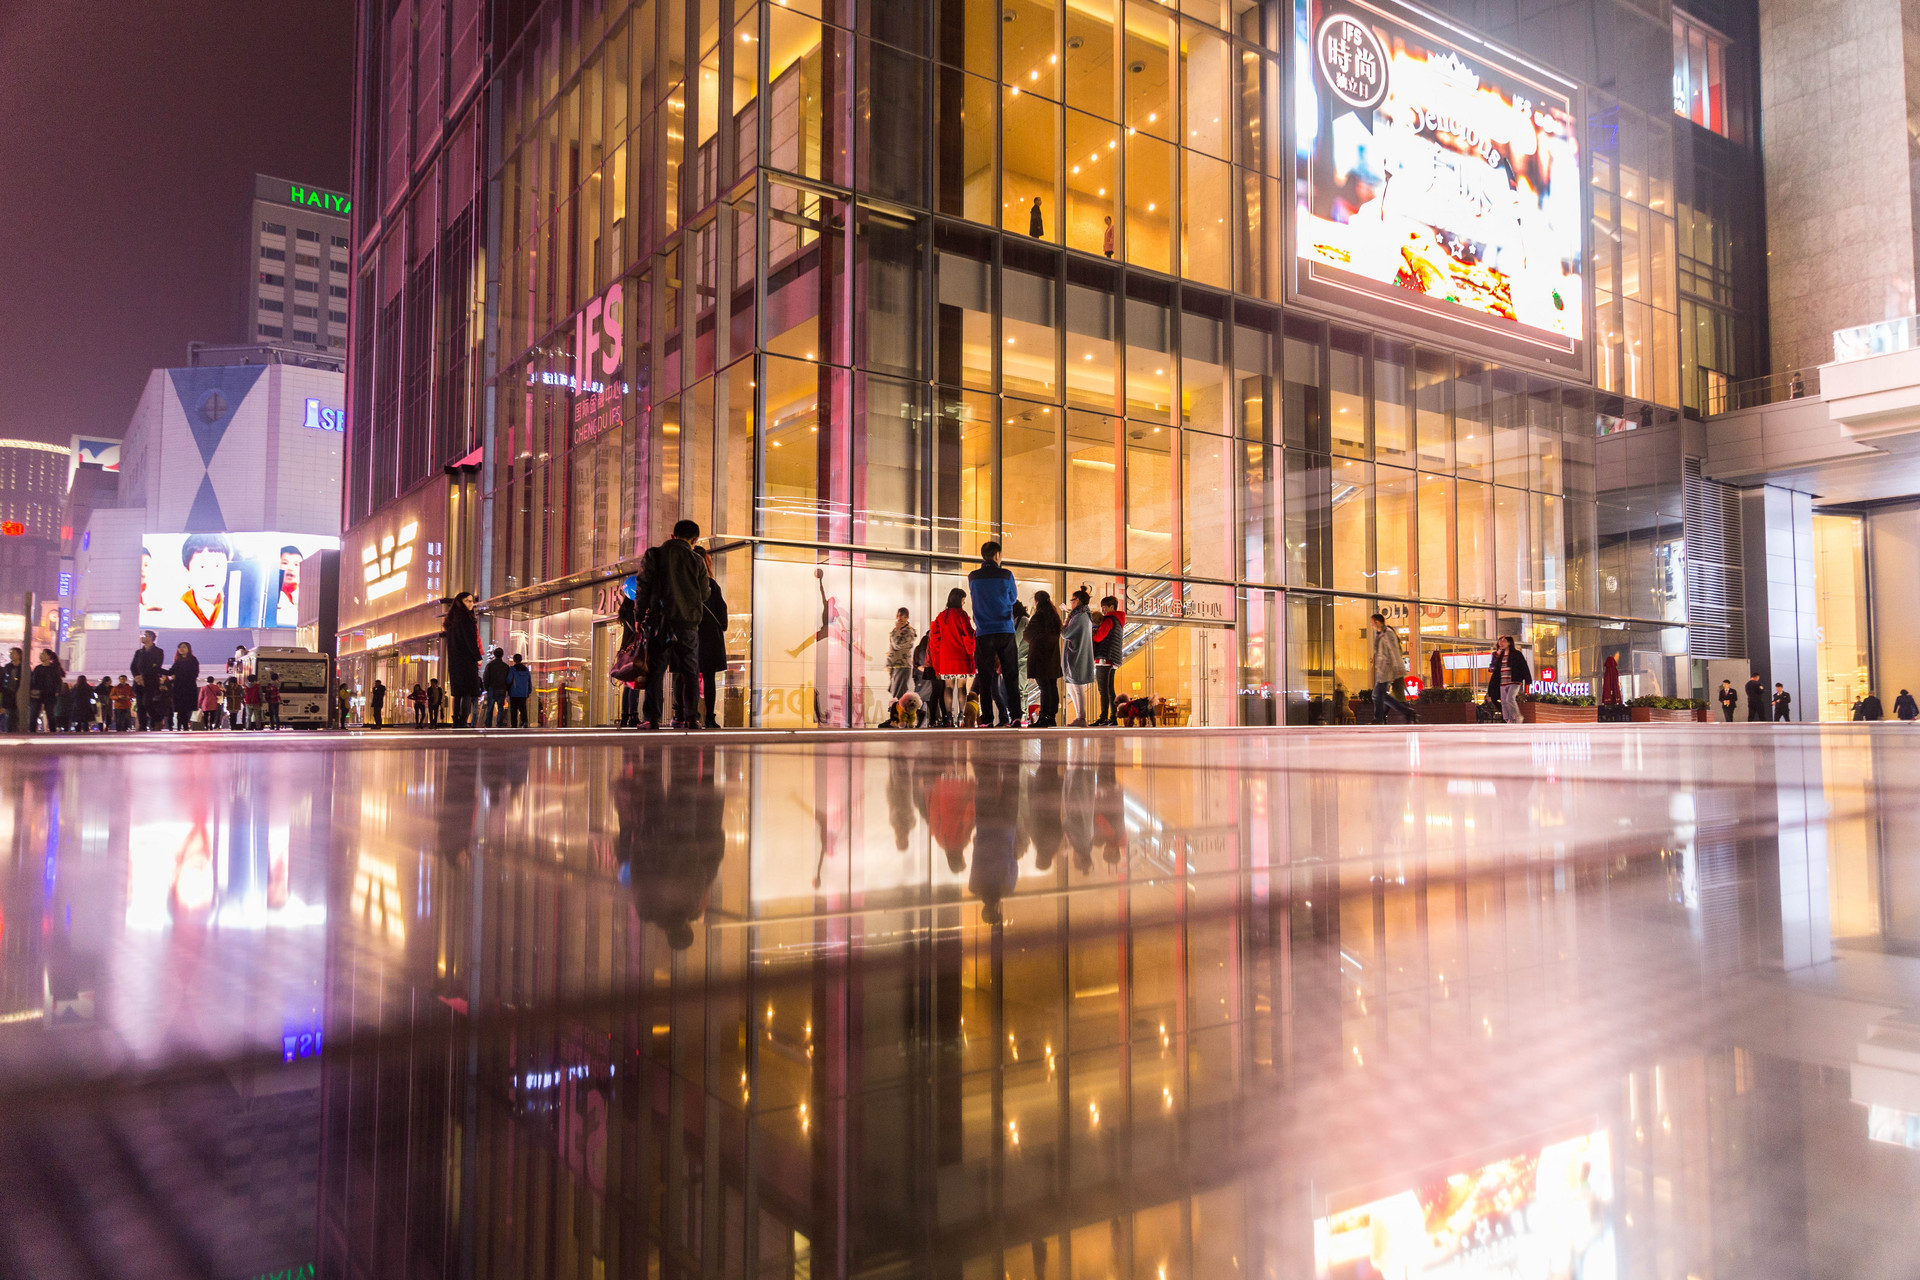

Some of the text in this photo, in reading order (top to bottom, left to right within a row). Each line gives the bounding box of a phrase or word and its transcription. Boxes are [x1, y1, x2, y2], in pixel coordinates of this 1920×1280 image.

[1342, 21, 1363, 46] IFS
[1327, 35, 1377, 85] 時尚
[575, 283, 622, 397] IFS
[575, 380, 621, 422] 国际金融中心
[574, 405, 621, 444] CHENGDU IFS
[597, 584, 624, 615] 2 IFS
[1559, 682, 1590, 696] COFFEE
